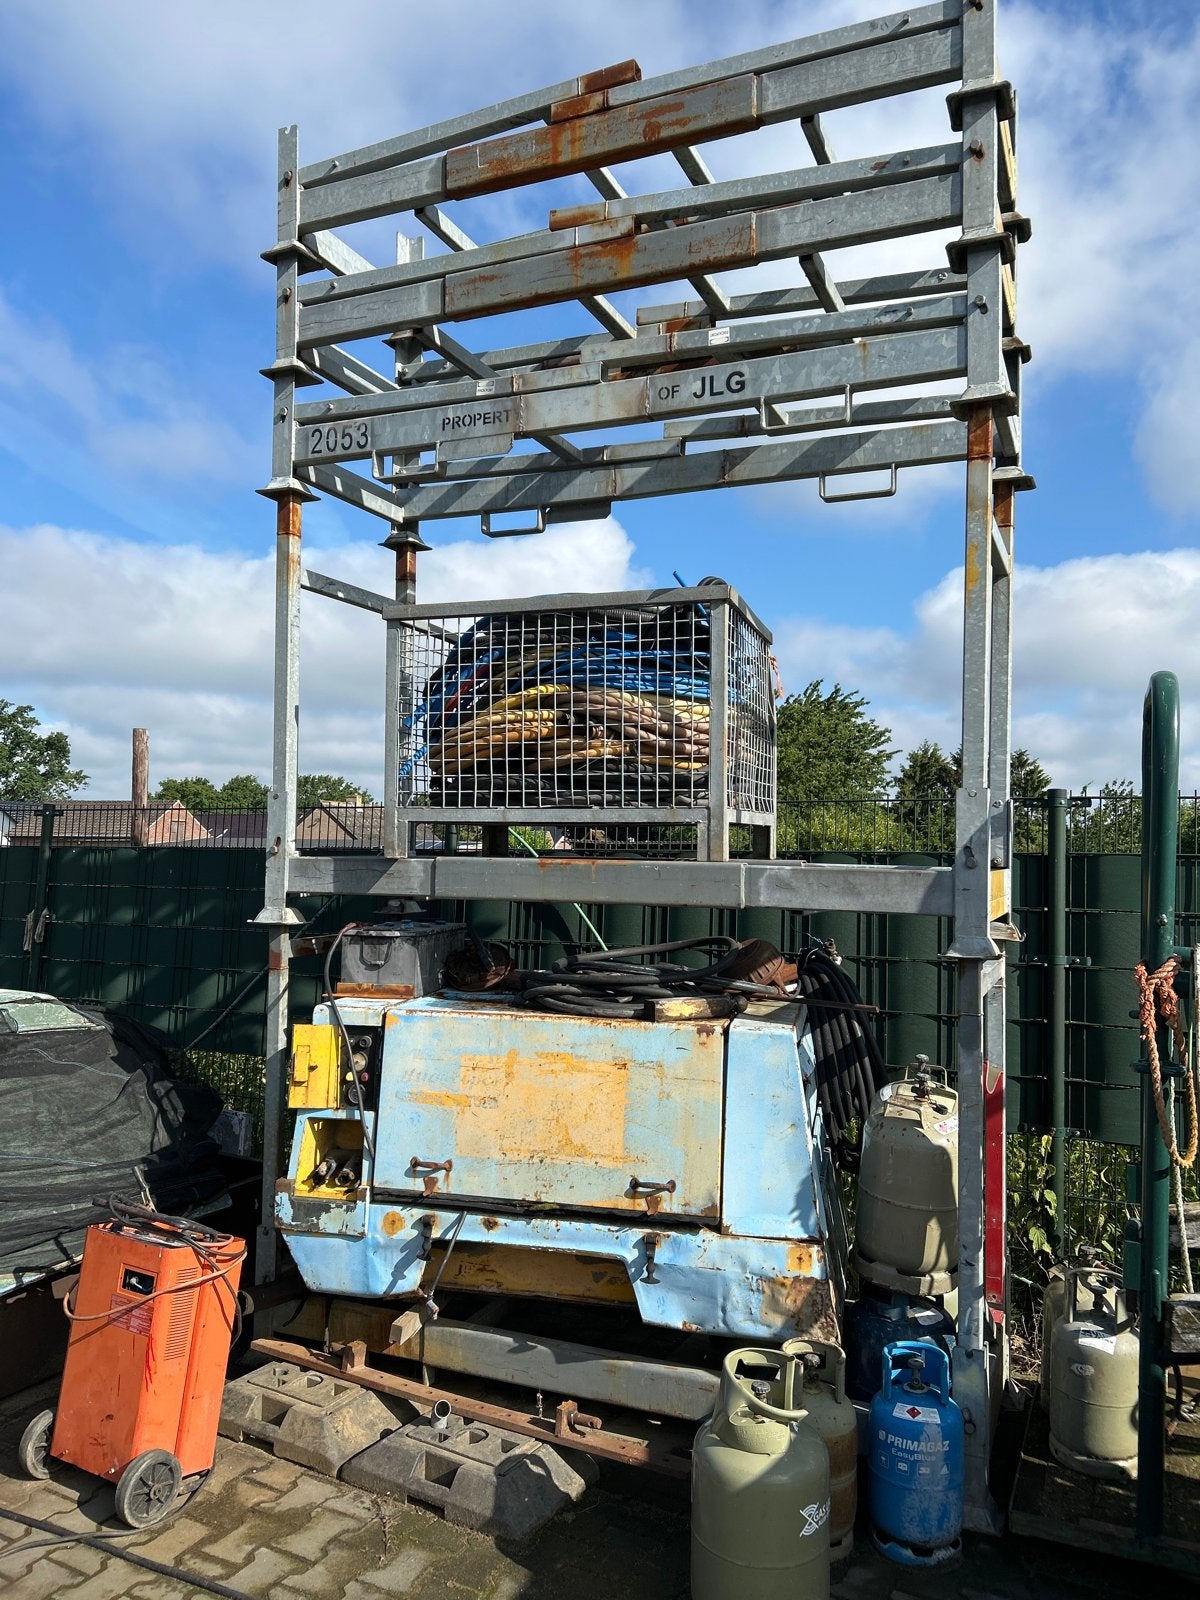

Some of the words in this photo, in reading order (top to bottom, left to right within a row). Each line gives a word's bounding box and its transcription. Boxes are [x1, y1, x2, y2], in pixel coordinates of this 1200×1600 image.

[657, 384, 680, 400] OF
[692, 370, 746, 399] JLG
[311, 422, 369, 455] 2053
[887, 1434, 950, 1452] PRIMAGAZ
[891, 1447, 937, 1461] EasyBlue
